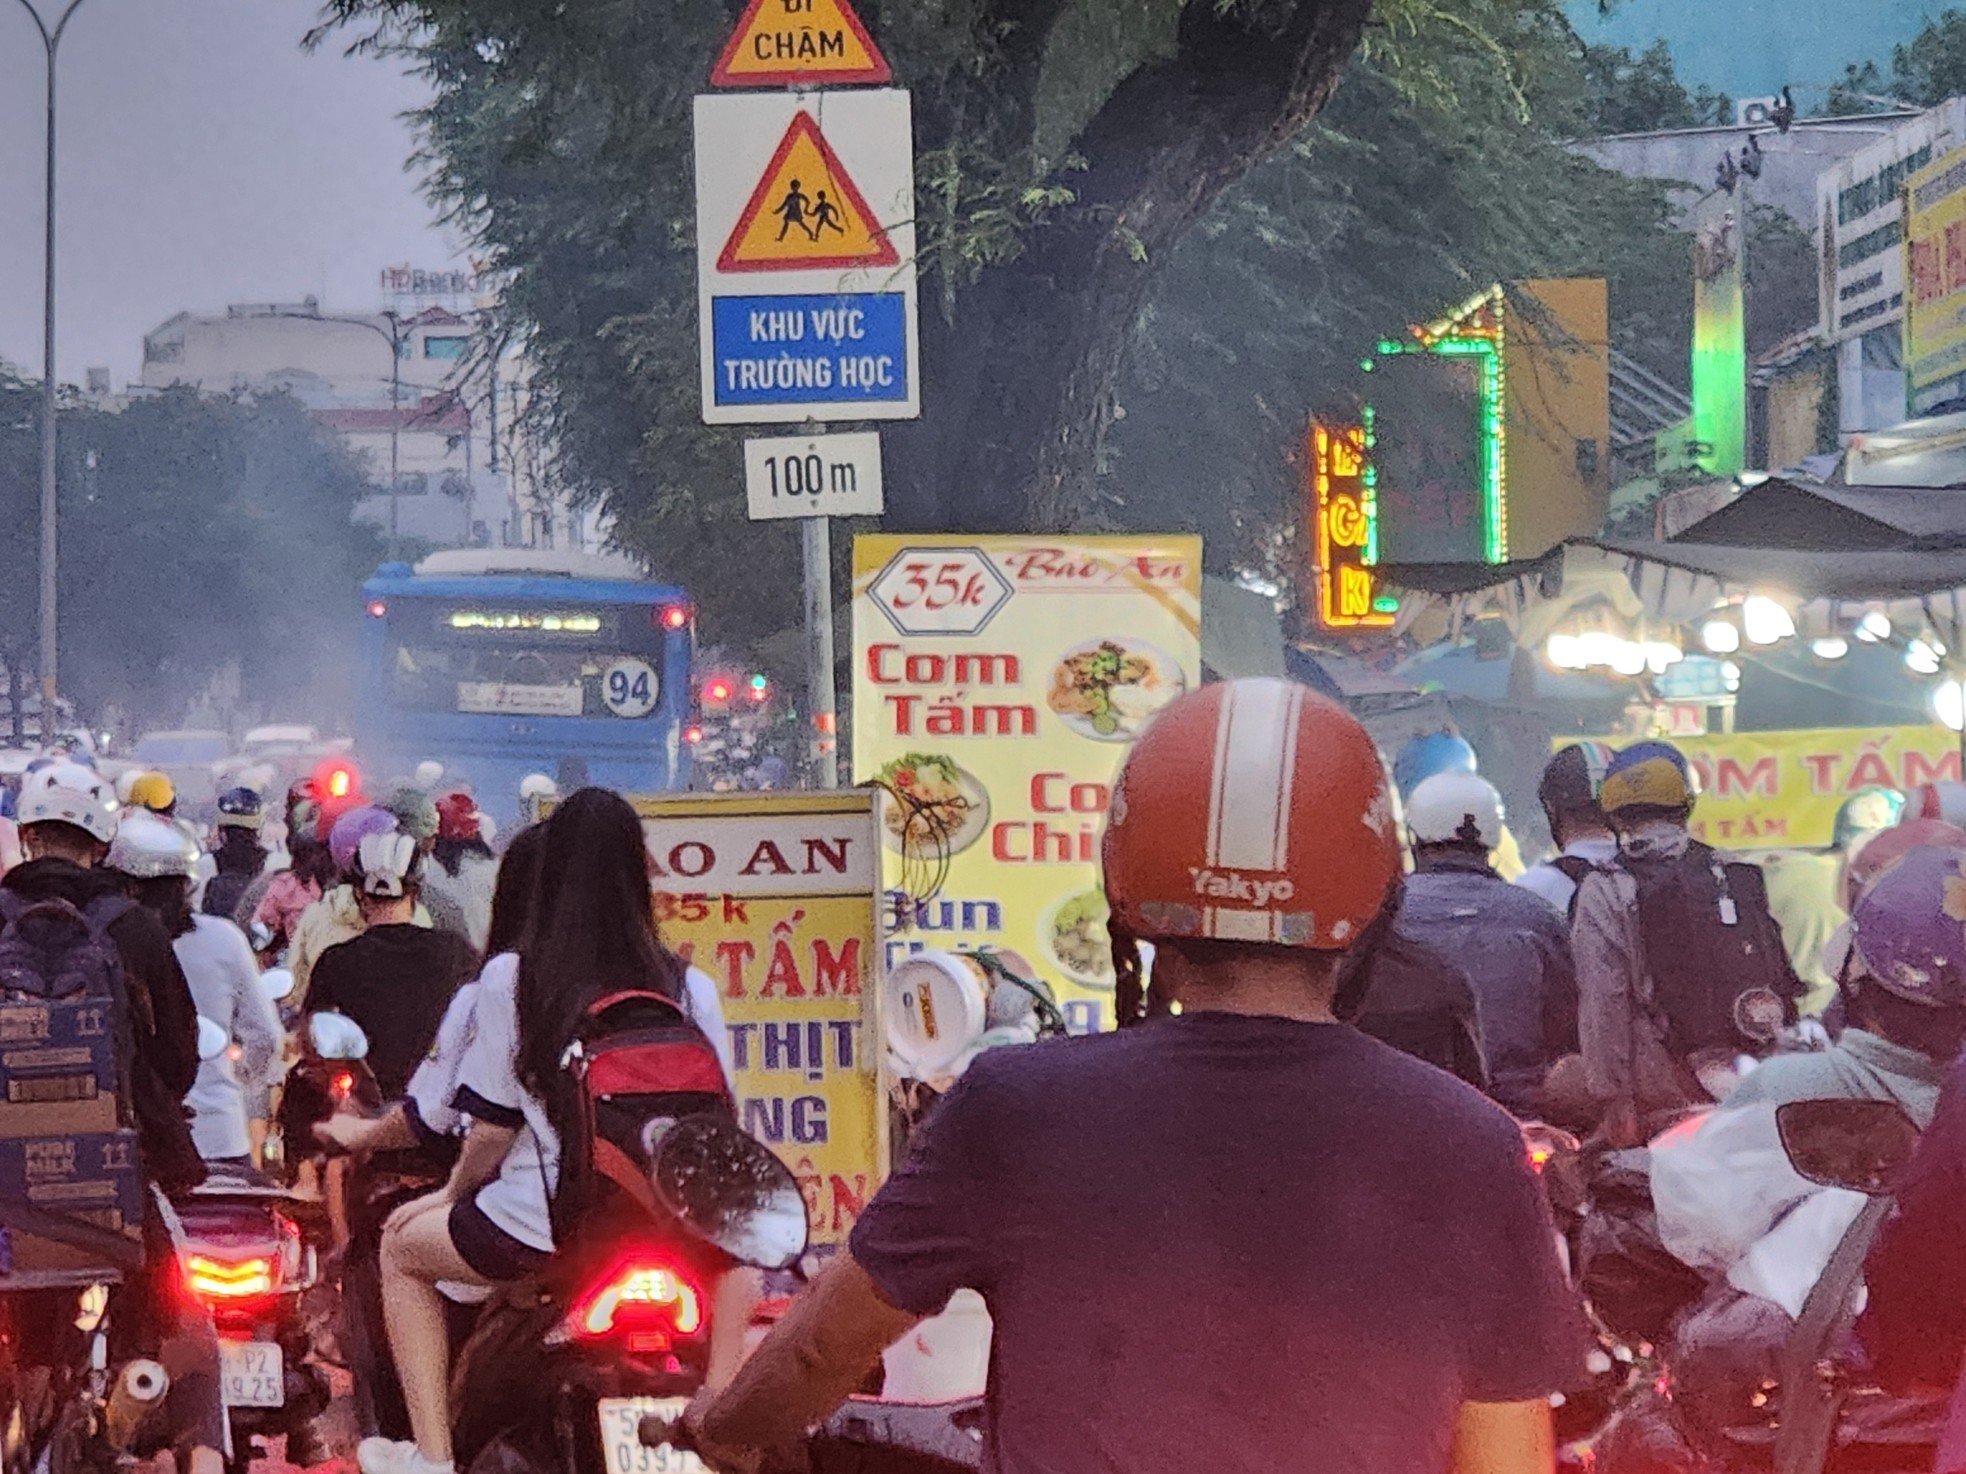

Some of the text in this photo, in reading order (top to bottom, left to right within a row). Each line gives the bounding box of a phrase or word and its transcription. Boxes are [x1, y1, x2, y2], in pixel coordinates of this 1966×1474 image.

[754, 26, 844, 63] CHẬM
[751, 307, 866, 346] KHU VỰC
[723, 351, 893, 392] TRƯỜNG HỌC
[765, 454, 857, 498] 100 m
[892, 563, 986, 611] 35k
[609, 670, 650, 706] 94
[884, 690, 1037, 736] Tấm
[737, 838, 854, 876] AN
[715, 909, 863, 998] TẤM
[726, 1021, 863, 1081] THỊT
